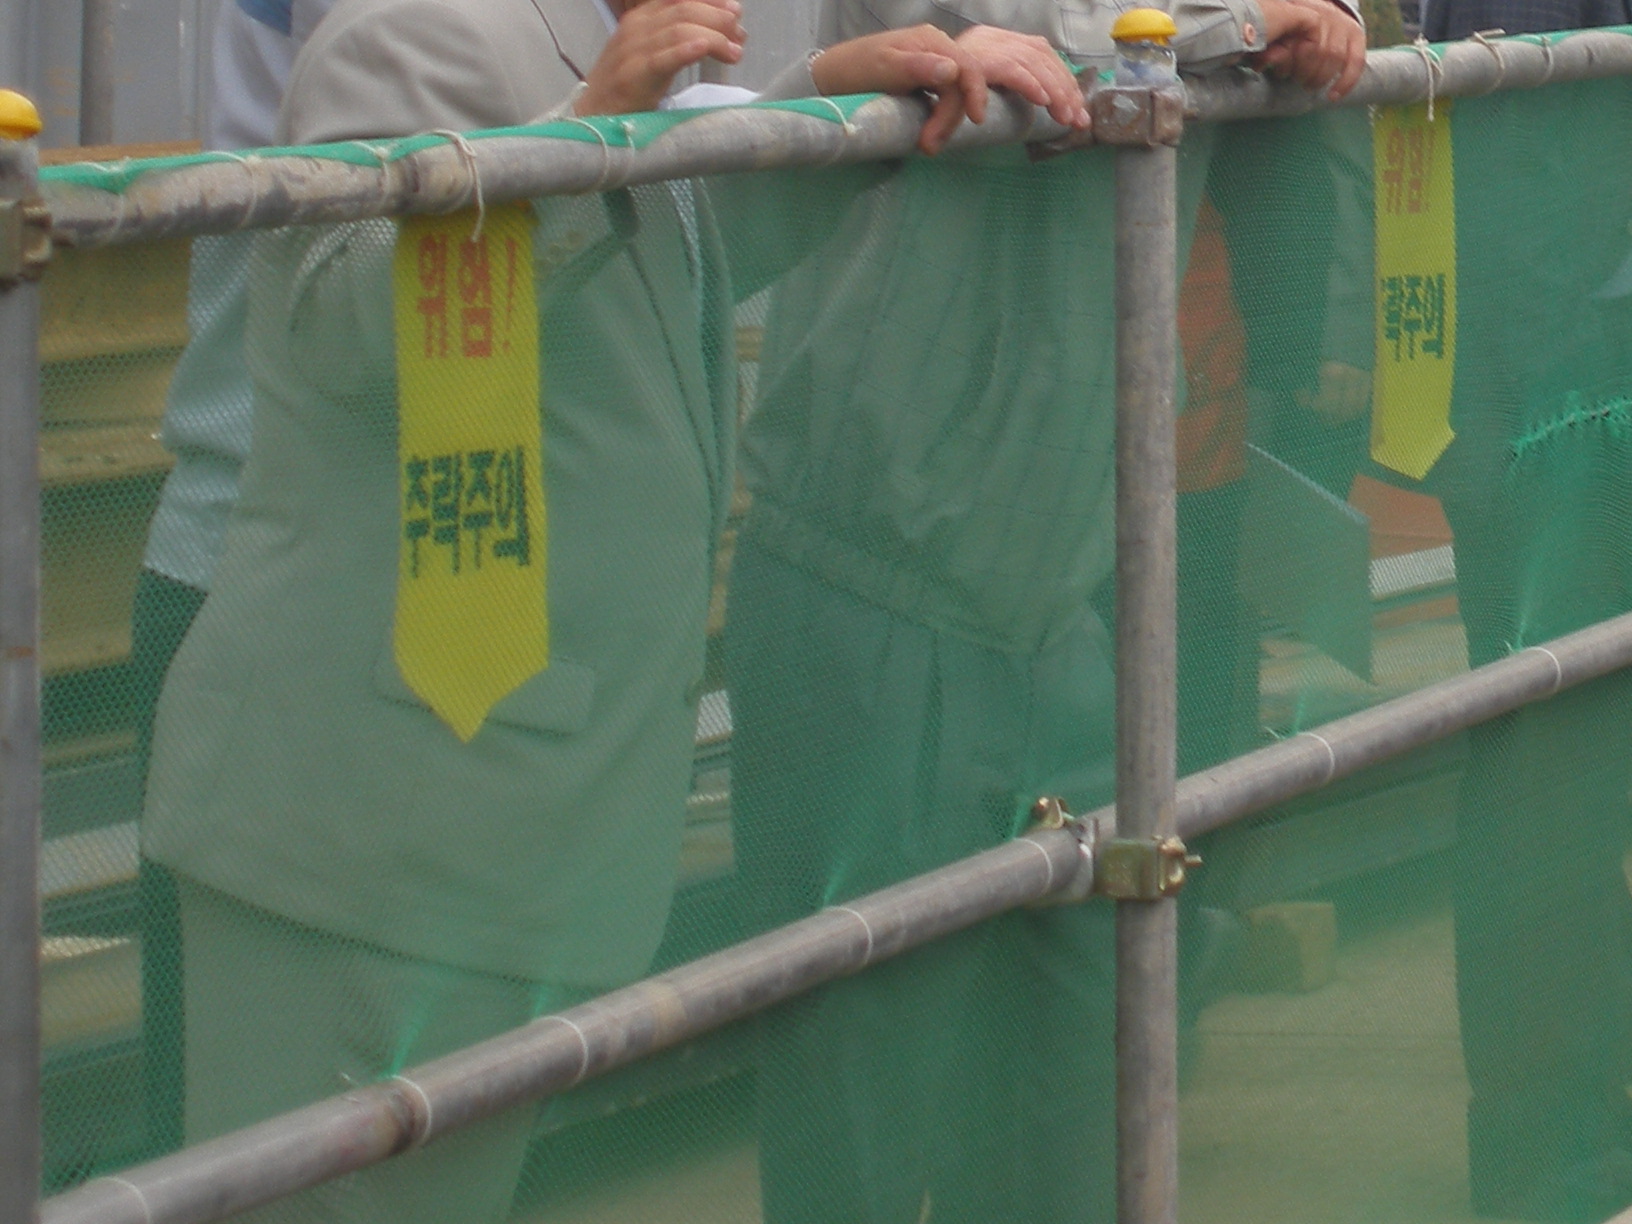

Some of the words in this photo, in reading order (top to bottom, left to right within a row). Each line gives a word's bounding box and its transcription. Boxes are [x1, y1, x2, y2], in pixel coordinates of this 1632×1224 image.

[417, 234, 517, 359] 위험!
[1381, 273, 1445, 363] 락주의
[406, 445, 530, 578] 추락주의
